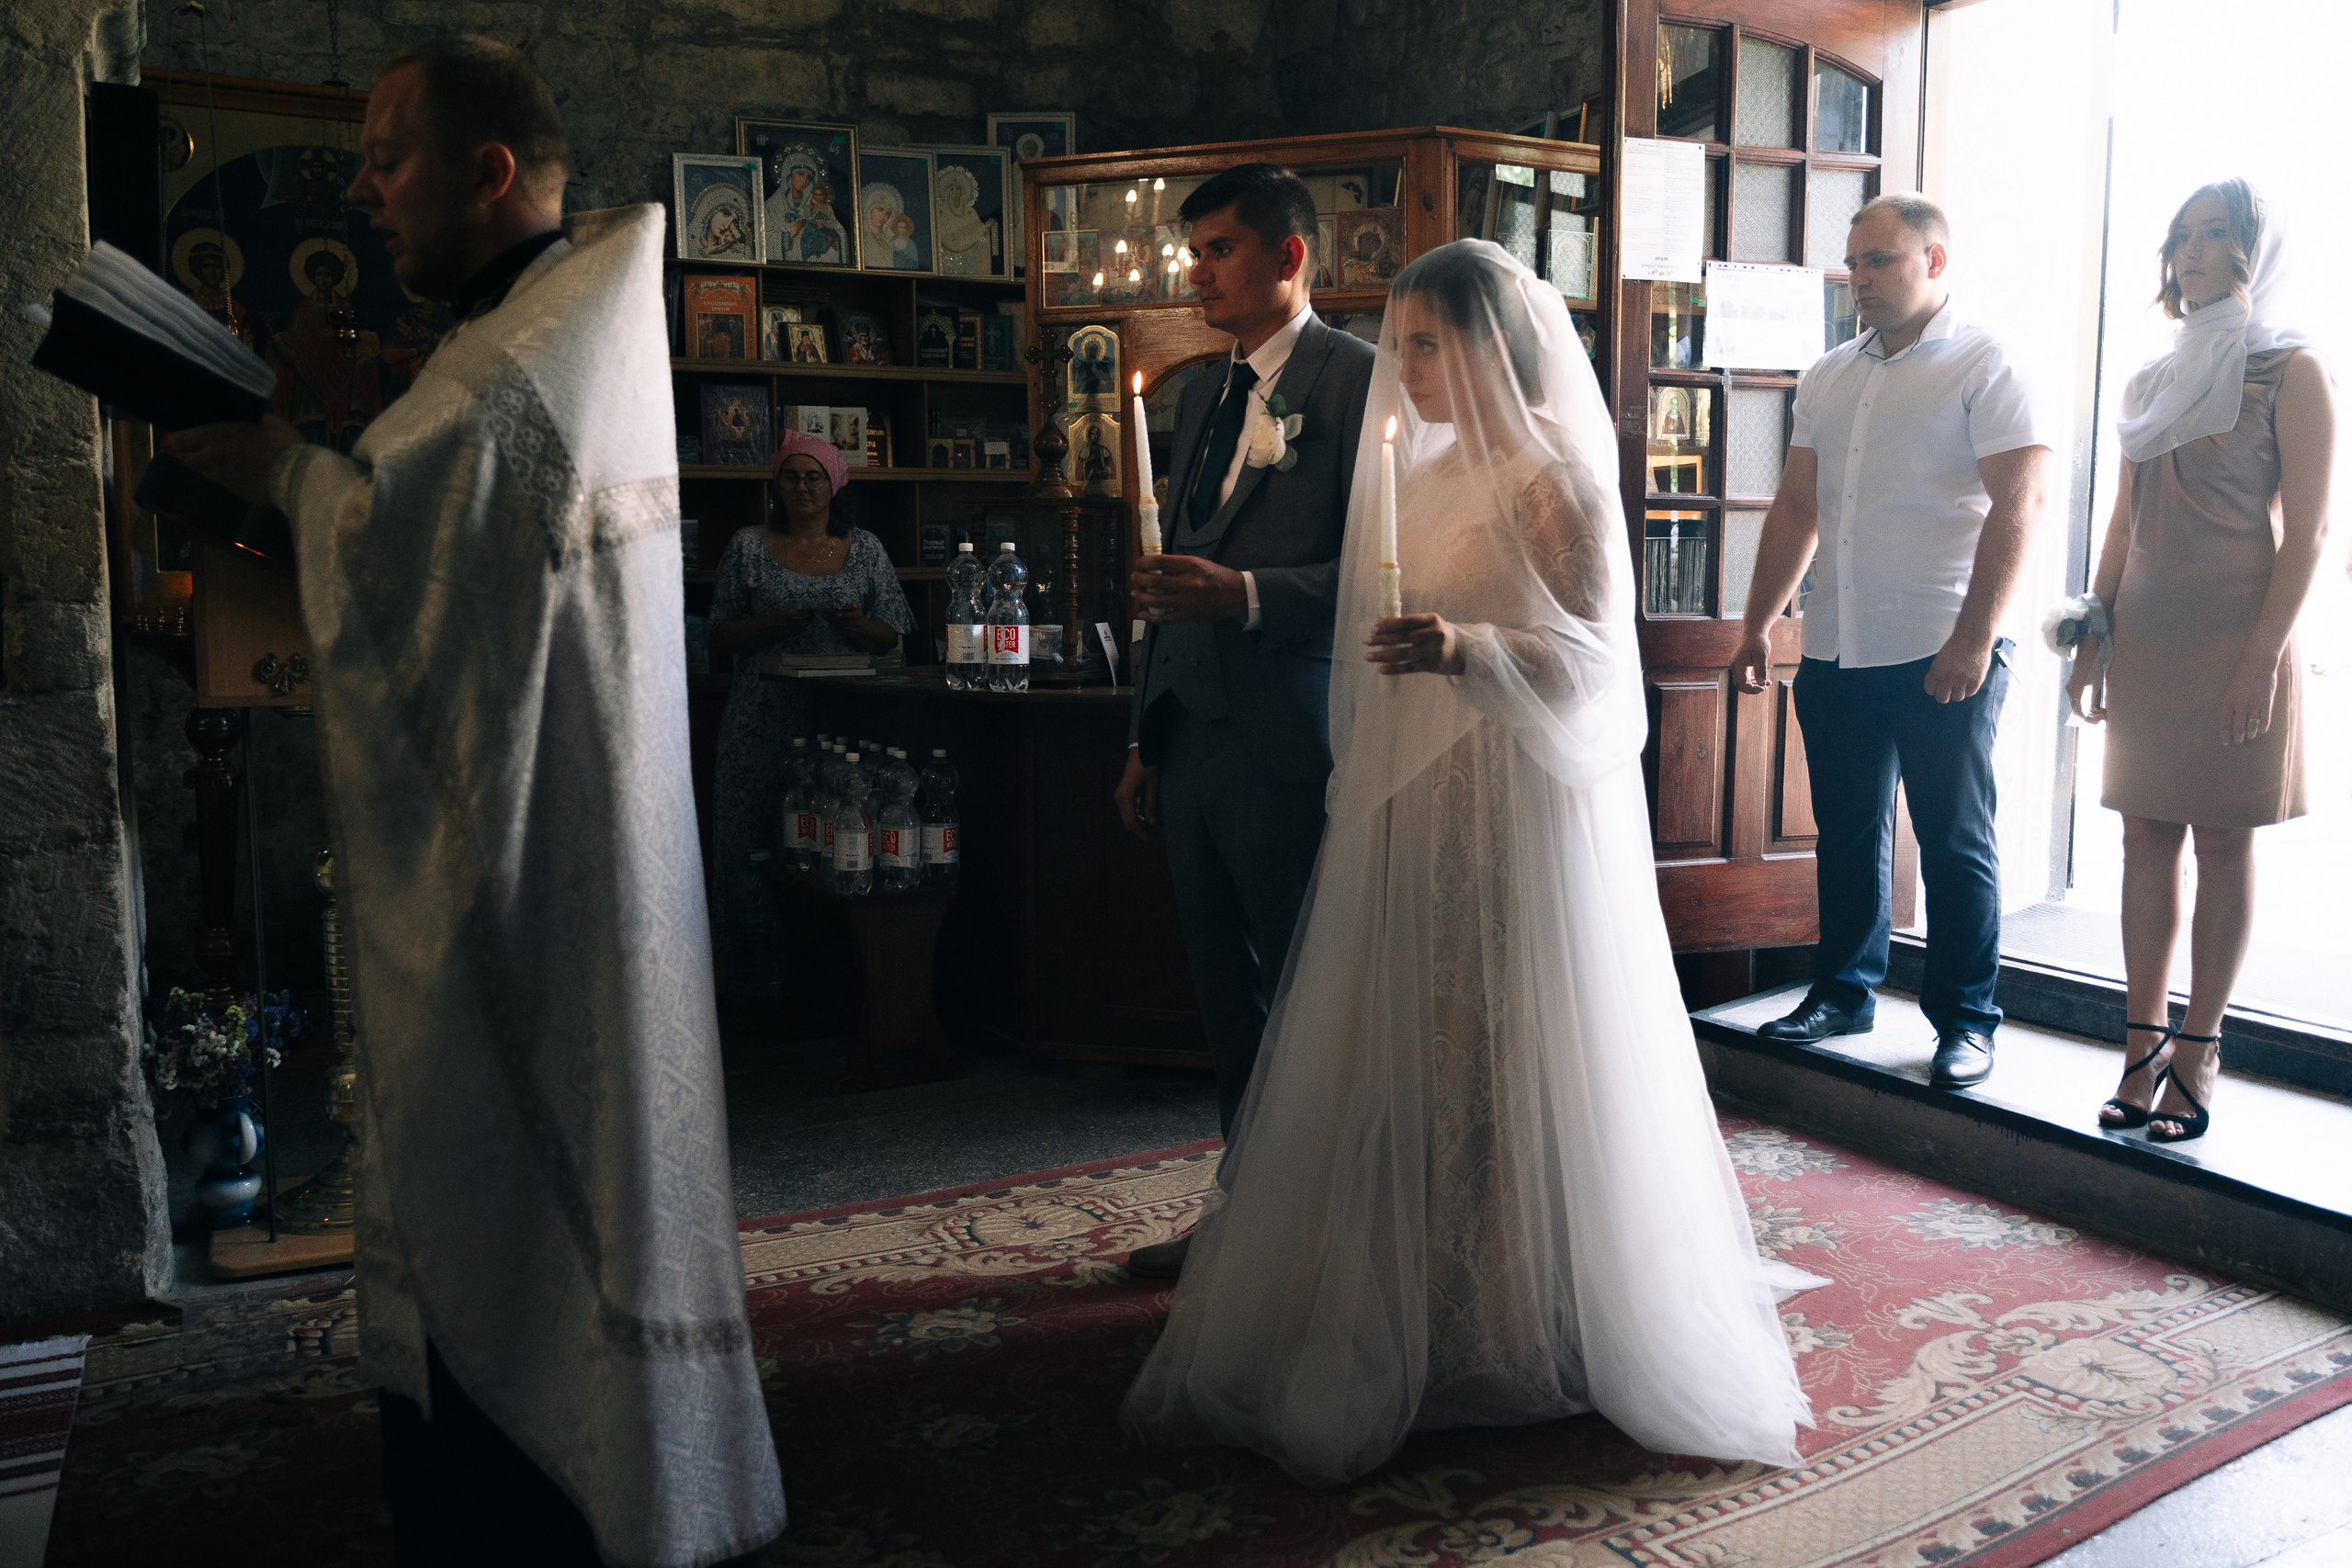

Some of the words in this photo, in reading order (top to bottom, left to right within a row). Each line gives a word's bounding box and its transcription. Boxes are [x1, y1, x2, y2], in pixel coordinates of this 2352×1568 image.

[997, 627, 1016, 641] ECO
[997, 640, 1016, 649] WTER
[882, 831, 896, 843] ECO
